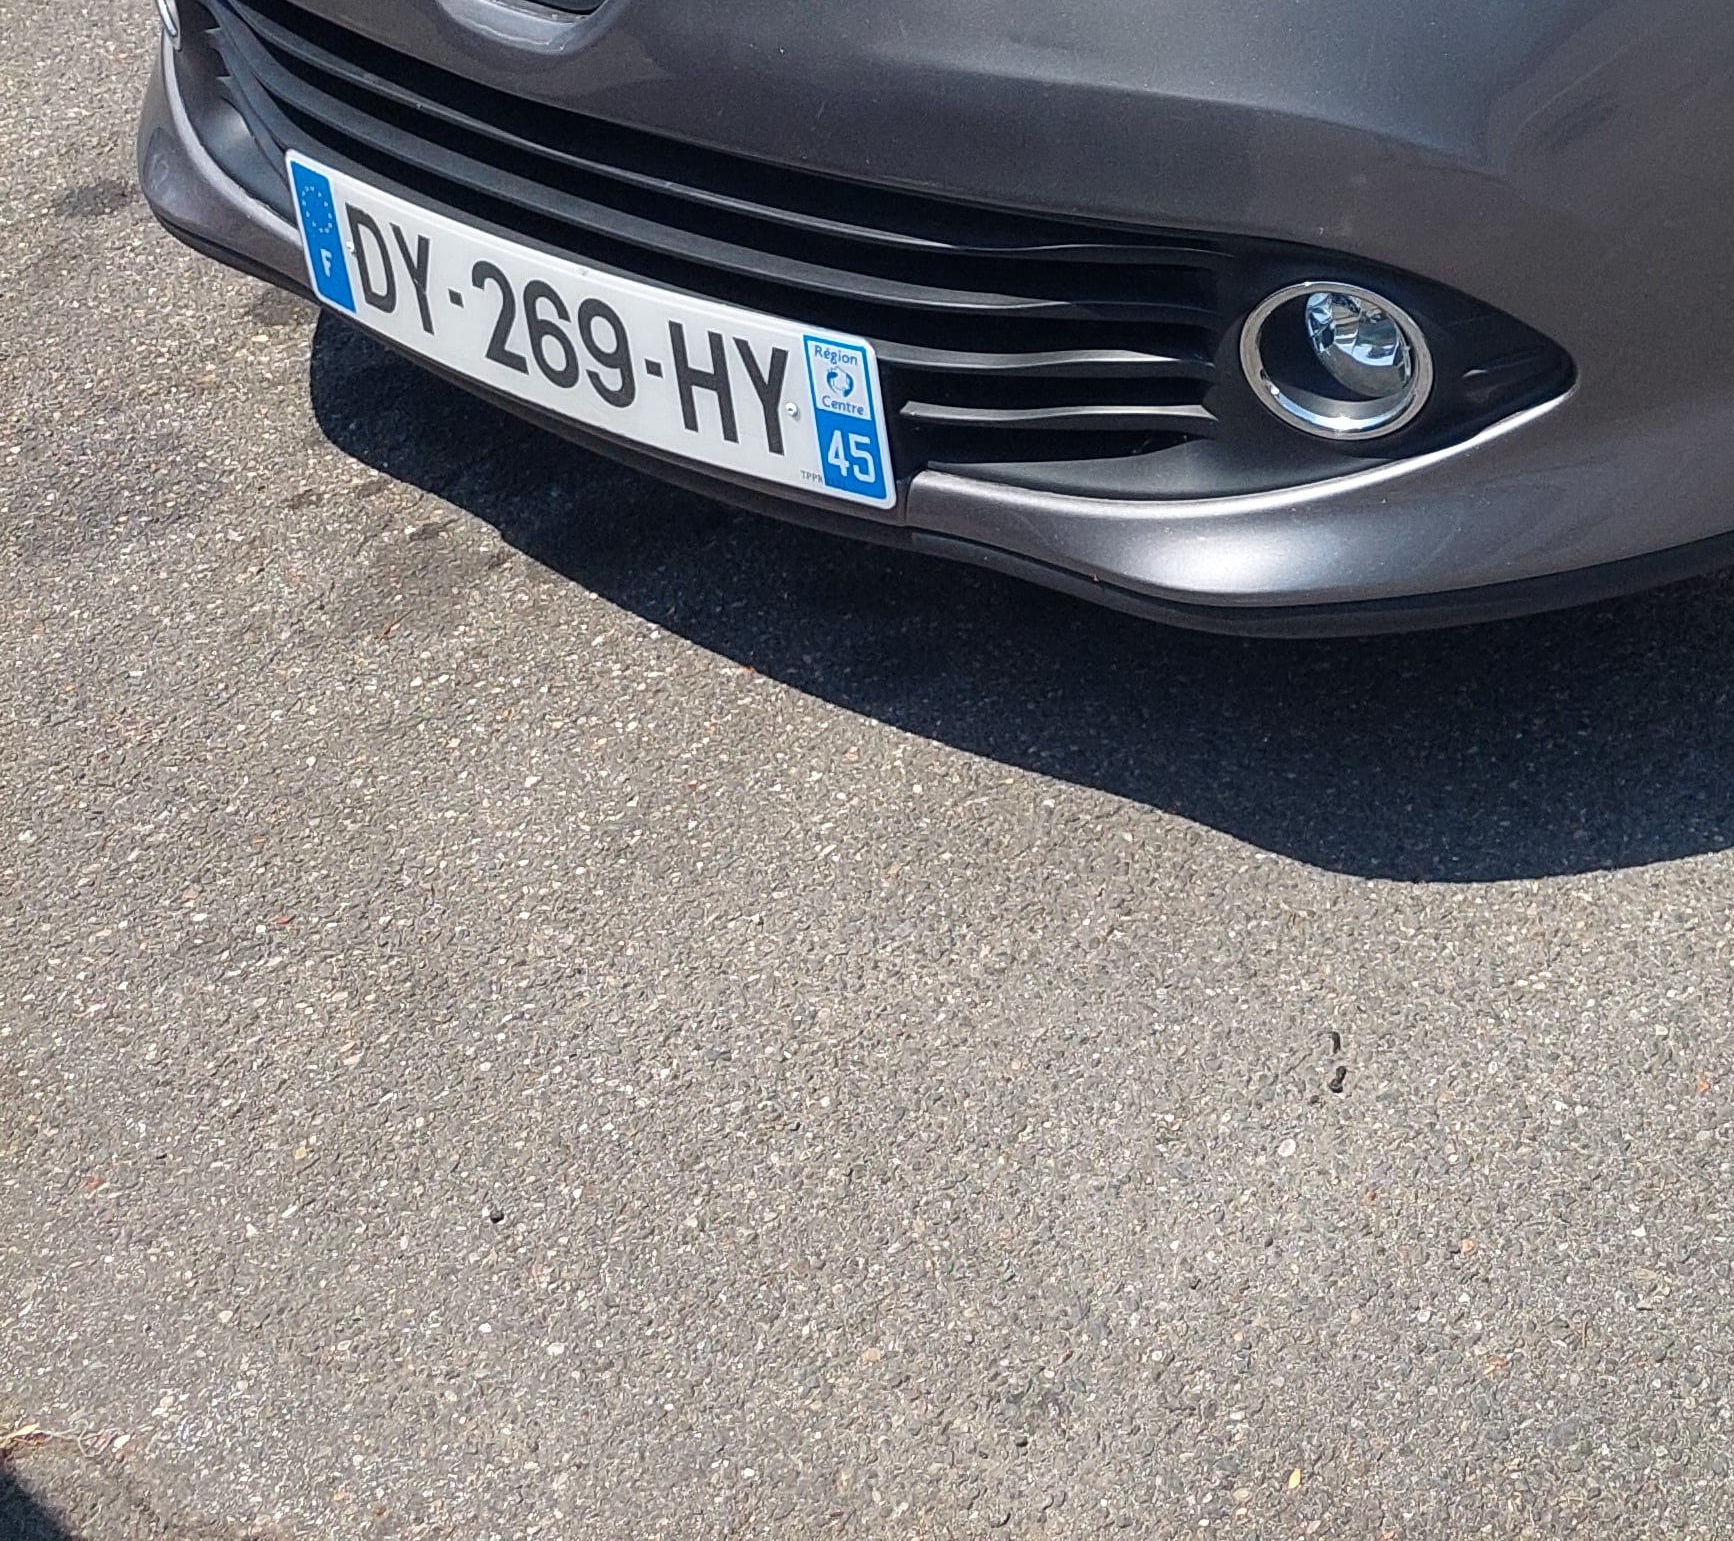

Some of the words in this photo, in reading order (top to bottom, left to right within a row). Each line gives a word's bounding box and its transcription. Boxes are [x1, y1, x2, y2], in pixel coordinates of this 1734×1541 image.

[320, 248, 333, 278] F
[344, 202, 789, 457] DY-269-HY
[814, 344, 858, 365] Région
[822, 395, 864, 416] Centre
[827, 429, 876, 484] 45
